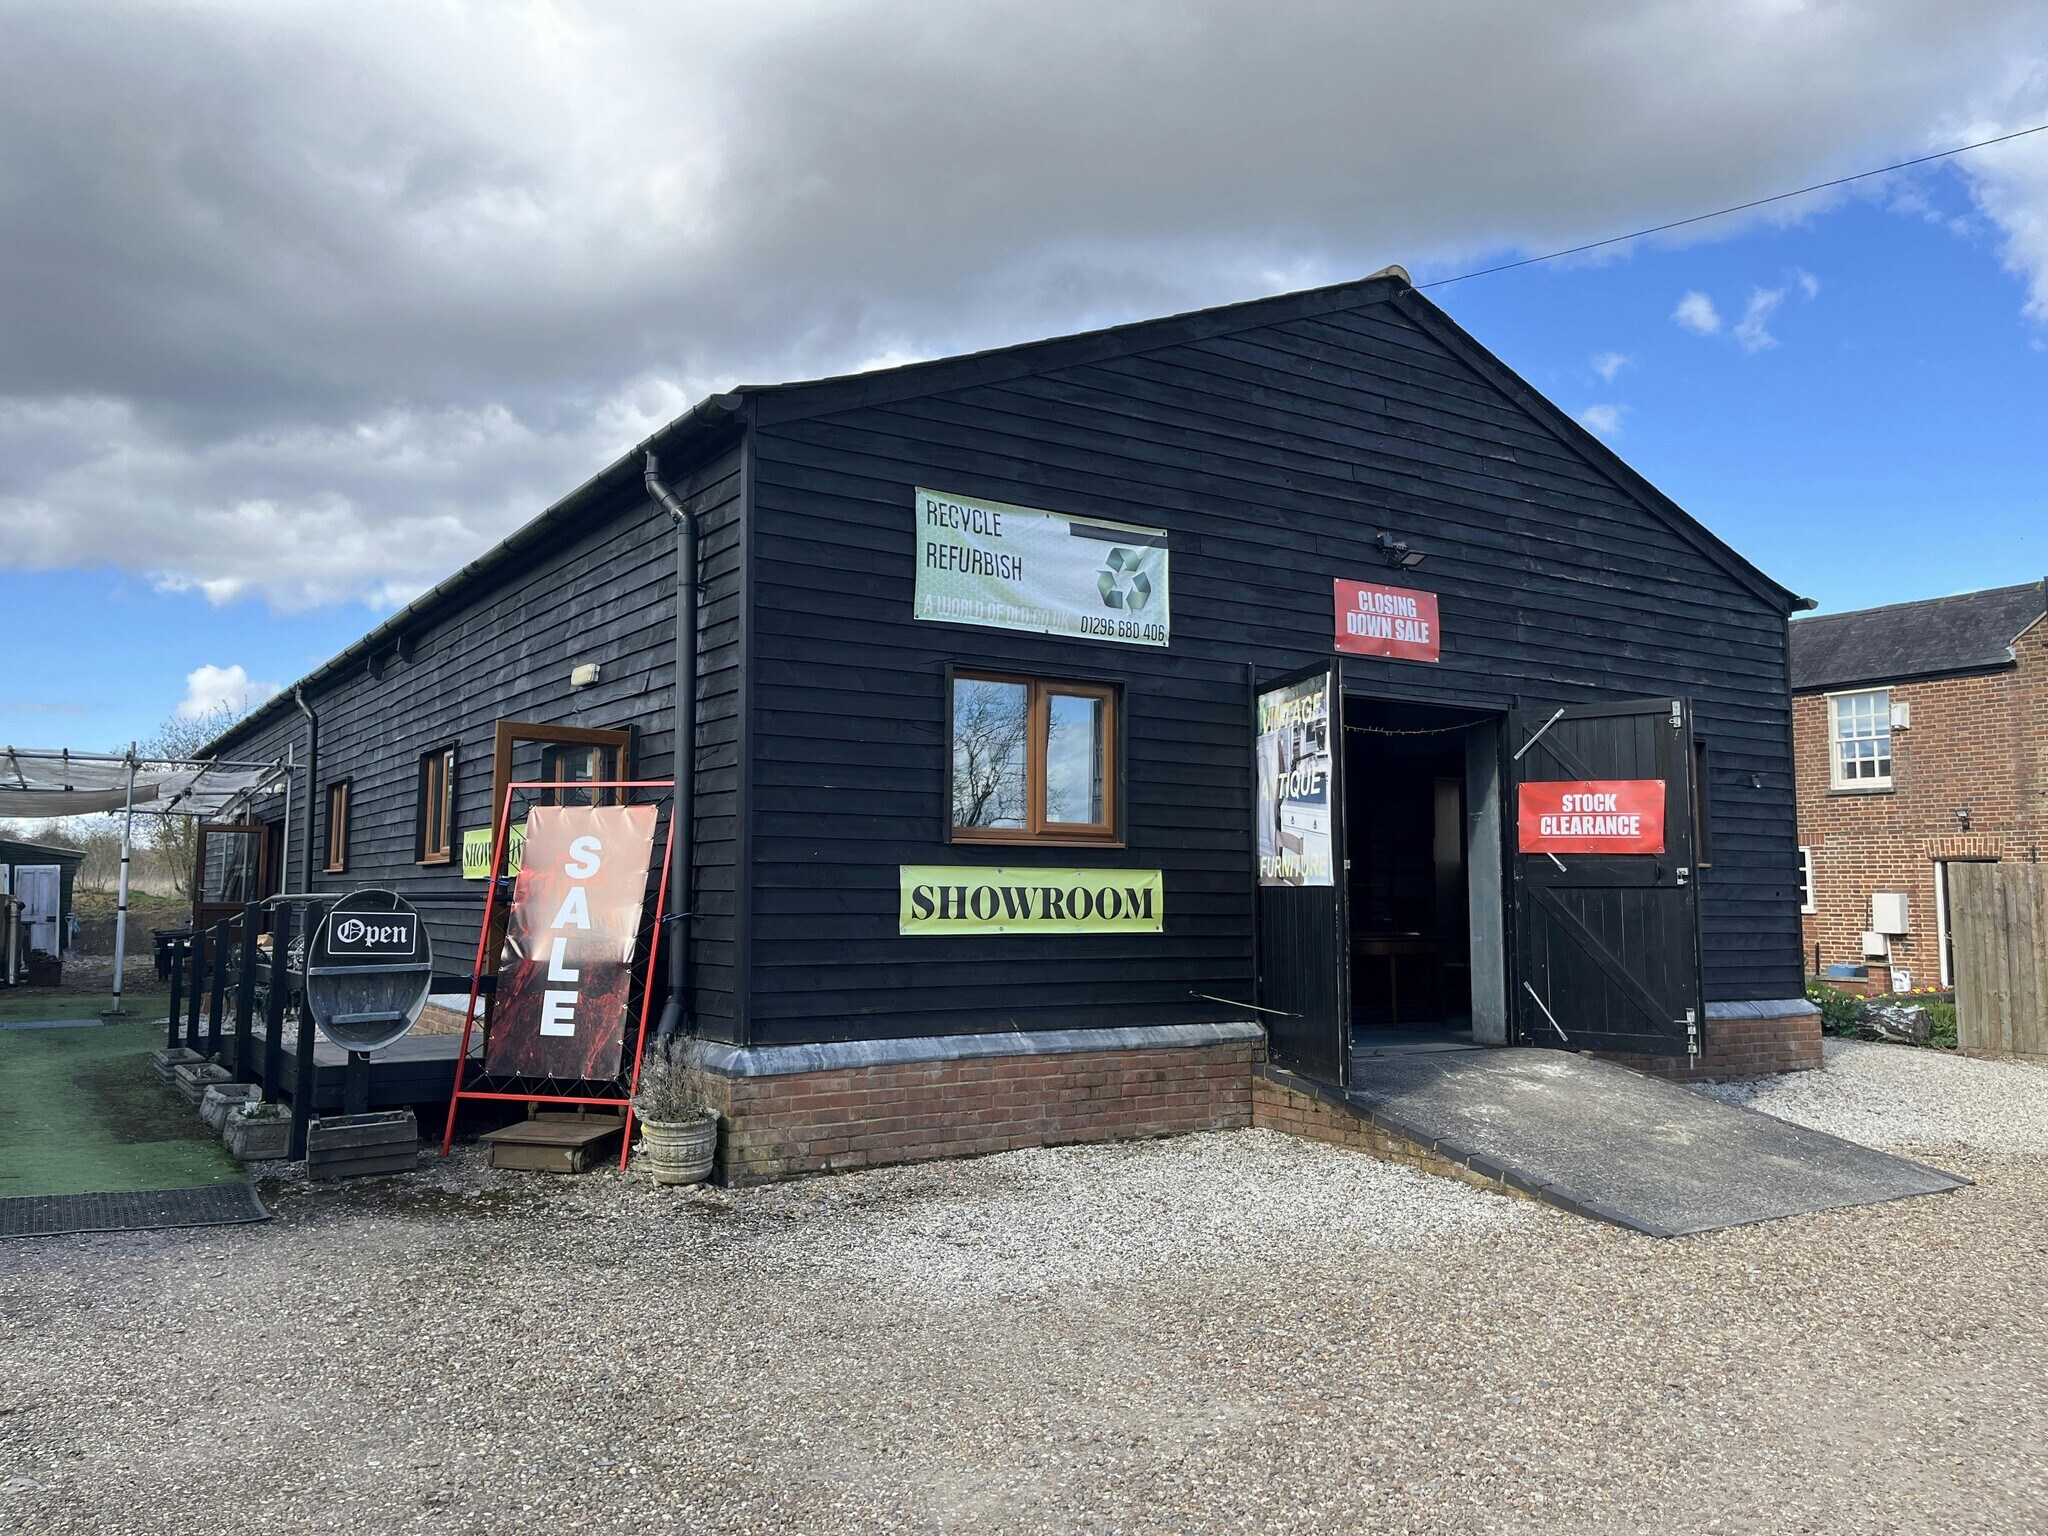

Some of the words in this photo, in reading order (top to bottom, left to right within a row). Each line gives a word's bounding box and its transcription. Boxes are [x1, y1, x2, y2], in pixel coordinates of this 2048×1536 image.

[926, 500, 1002, 537] RECYCLE
[926, 542, 1022, 581] REFURBISH
[1358, 590, 1417, 618] CLOSING
[1080, 615, 1115, 636] 01296
[1118, 620, 1140, 639] 680
[1143, 623, 1165, 642] 406
[1346, 612, 1393, 639] DOWN
[1394, 618, 1430, 644] SALE
[1262, 691, 1324, 735] VINTAGE
[1561, 793, 1618, 813] STOCK
[1540, 815, 1641, 836] CLEARANCE
[1259, 855, 1327, 879] FURNITURE
[911, 884, 1154, 921] SHOWROOM
[336, 918, 408, 948] Open
[539, 836, 602, 1037] SALE
